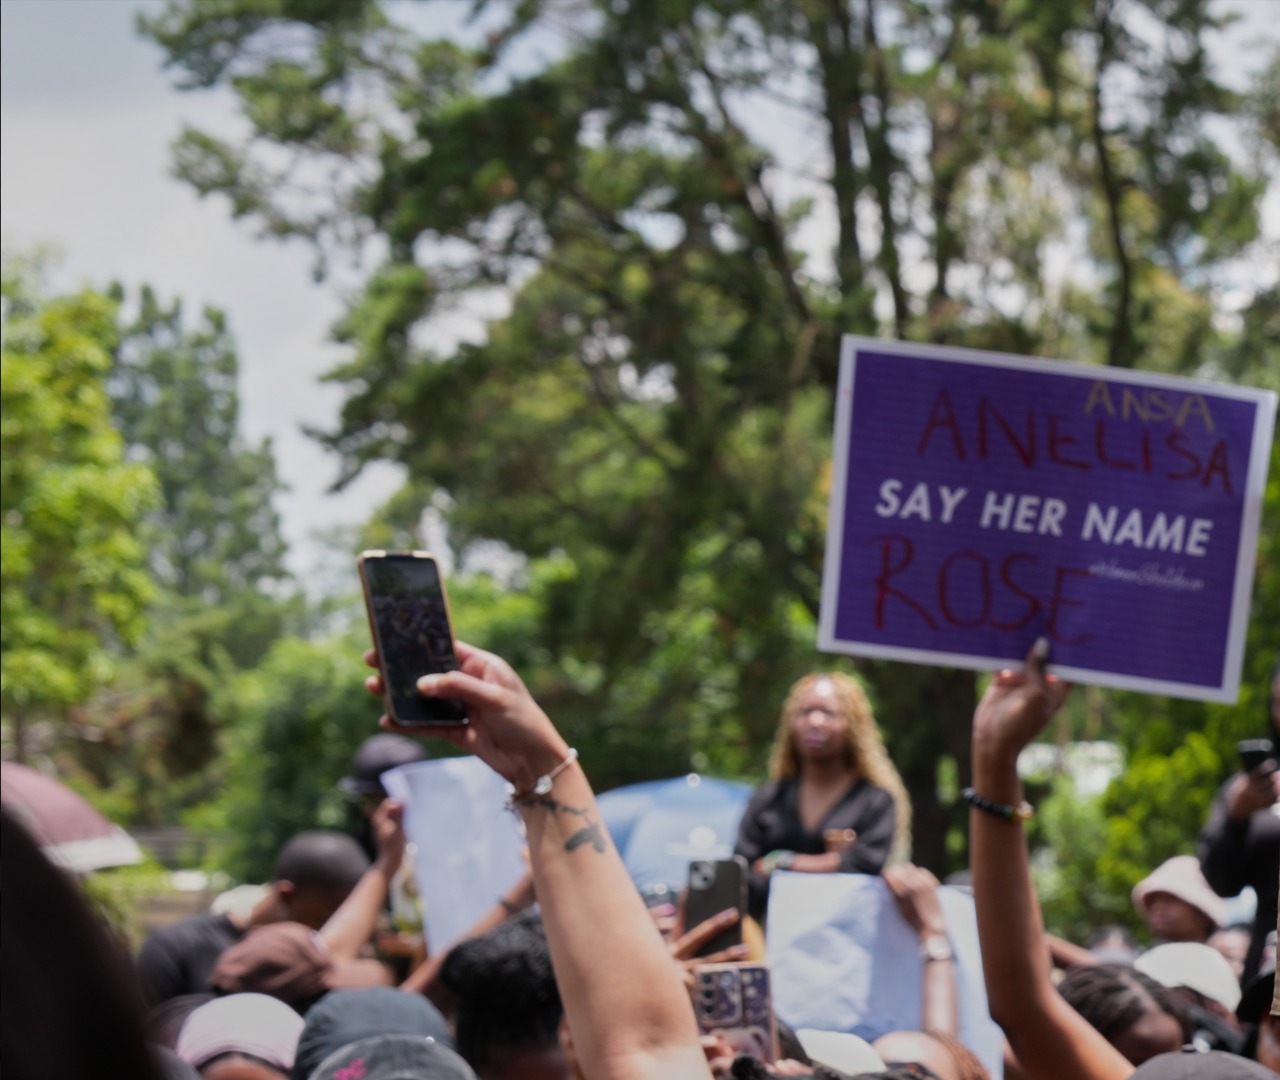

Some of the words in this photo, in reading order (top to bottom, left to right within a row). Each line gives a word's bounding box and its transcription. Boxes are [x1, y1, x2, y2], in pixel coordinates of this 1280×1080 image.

[917, 391, 1233, 495] ANELISA
[1086, 379, 1215, 431] ANSA
[875, 478, 967, 524] SAY
[980, 491, 1067, 537] HER
[1081, 502, 1214, 557] NAME
[869, 534, 1095, 643] ROSE
